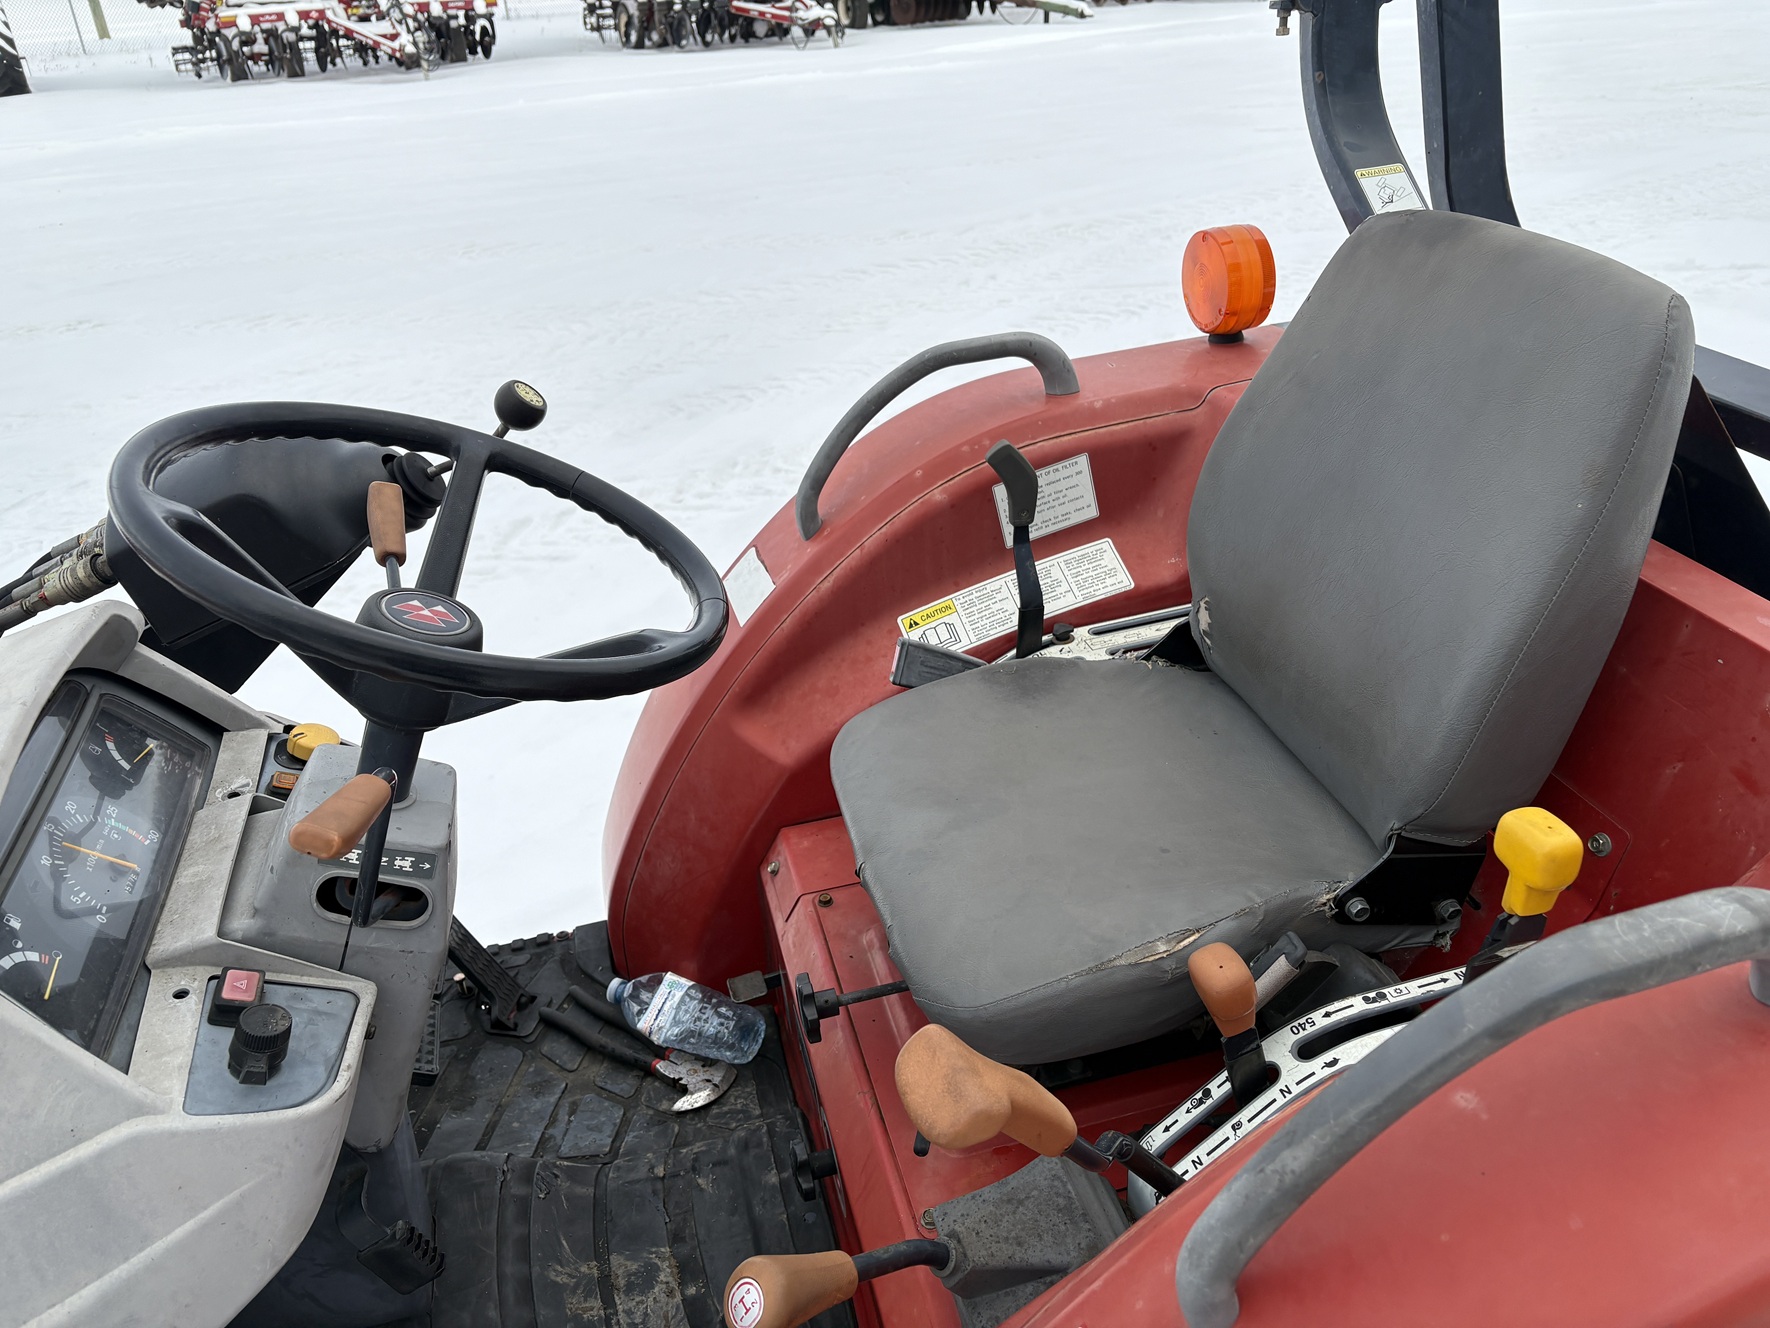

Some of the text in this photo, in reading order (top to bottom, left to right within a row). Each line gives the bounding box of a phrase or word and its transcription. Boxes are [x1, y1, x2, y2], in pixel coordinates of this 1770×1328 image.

[1366, 166, 1402, 176] WARNING
[1061, 461, 1078, 469] FILTER
[920, 604, 952, 622] CAUTION
[65, 801, 77, 814] 20
[107, 805, 118, 818] 25
[44, 823, 54, 833] 15
[149, 830, 159, 842] 30
[41, 855, 52, 867] 10
[71, 895, 81, 904] 5
[96, 915, 107, 924] 0
[1290, 1016, 1316, 1036] 540
[1279, 1085, 1293, 1098] N
[1191, 1156, 1204, 1170] N
[751, 1299, 758, 1307] 2
